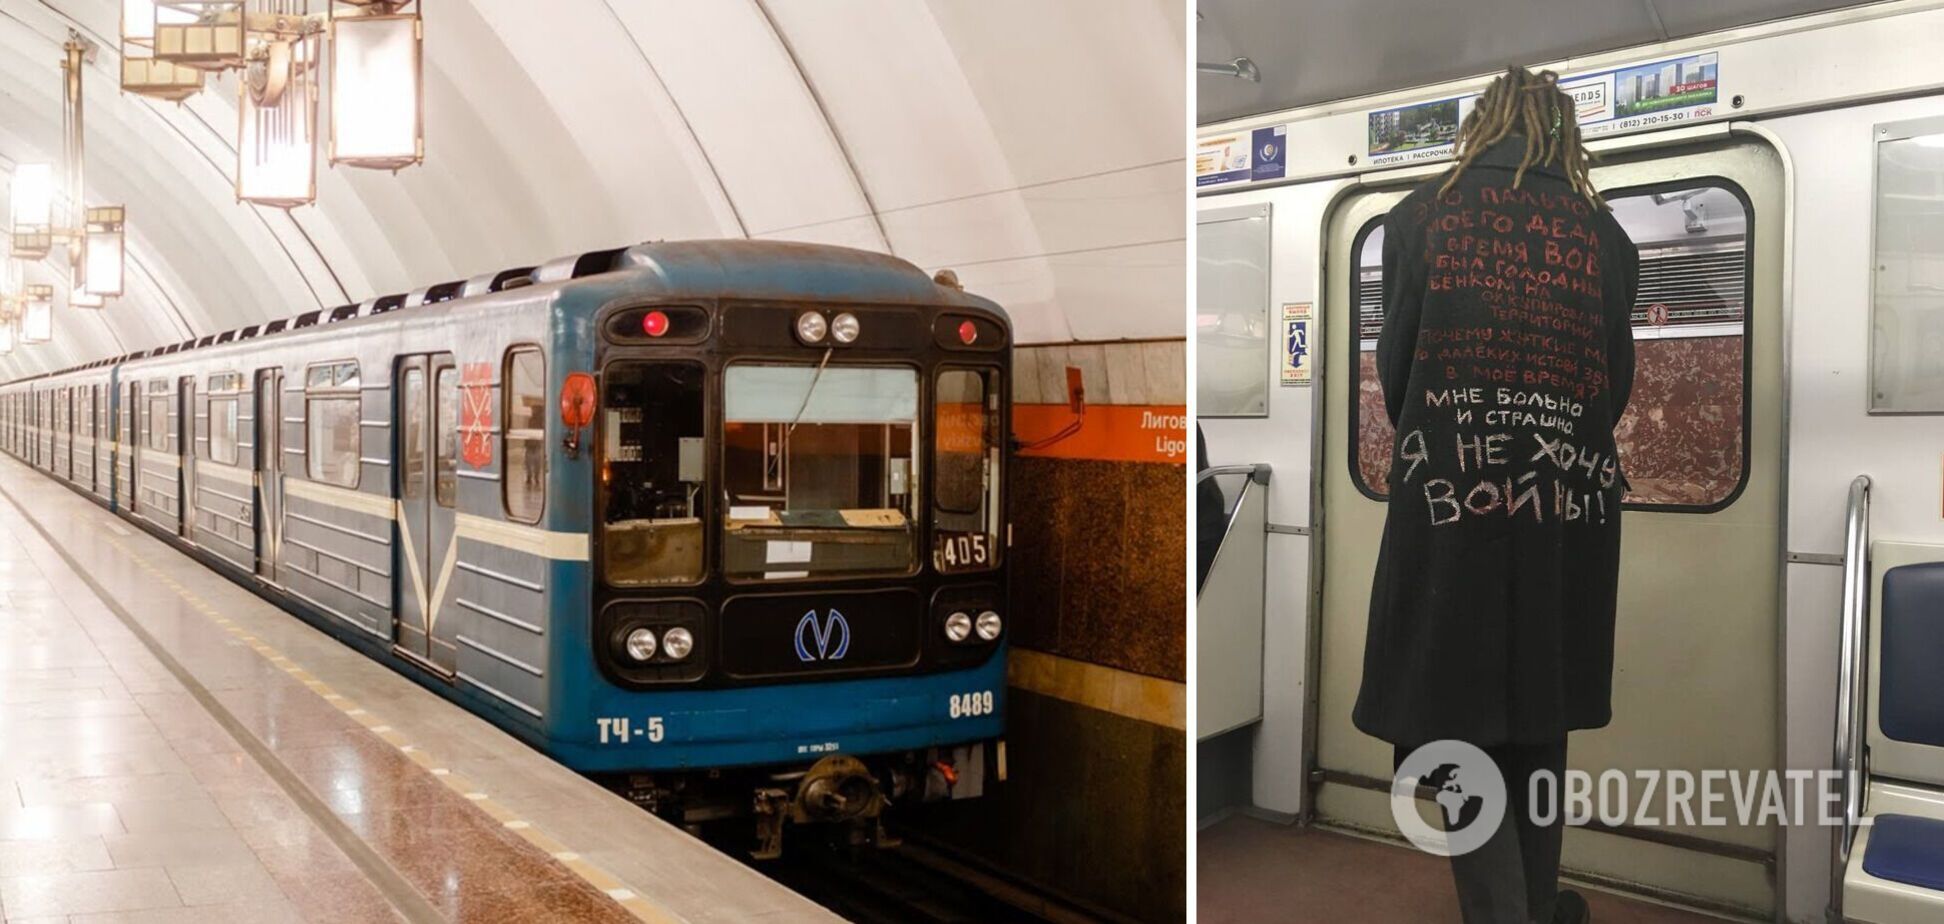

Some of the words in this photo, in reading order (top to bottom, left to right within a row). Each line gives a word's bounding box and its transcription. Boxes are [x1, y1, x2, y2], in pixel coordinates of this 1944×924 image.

[1619, 120, 1640, 129] (812)
[1643, 113, 1684, 125] 210-15-30
[1694, 108, 1713, 118] ПСК
[1373, 155, 1404, 165] ИПОТЕКА
[1525, 213, 1599, 249] ДЕДА
[1446, 234, 1528, 264] ВРЕМЯ
[1436, 254, 1485, 272] БЫЛ
[1525, 282, 1551, 298] НА
[1425, 387, 1485, 408] МНЕ
[1457, 408, 1473, 426] И
[1156, 435, 1186, 457] Ligo
[1400, 429, 1430, 483] Я
[1456, 432, 1515, 473] НЕ
[1529, 432, 1617, 489] ХОЧУ
[1423, 471, 1607, 526] ВОЙНЫ!
[944, 534, 987, 565] 405
[949, 689, 994, 719] 8489
